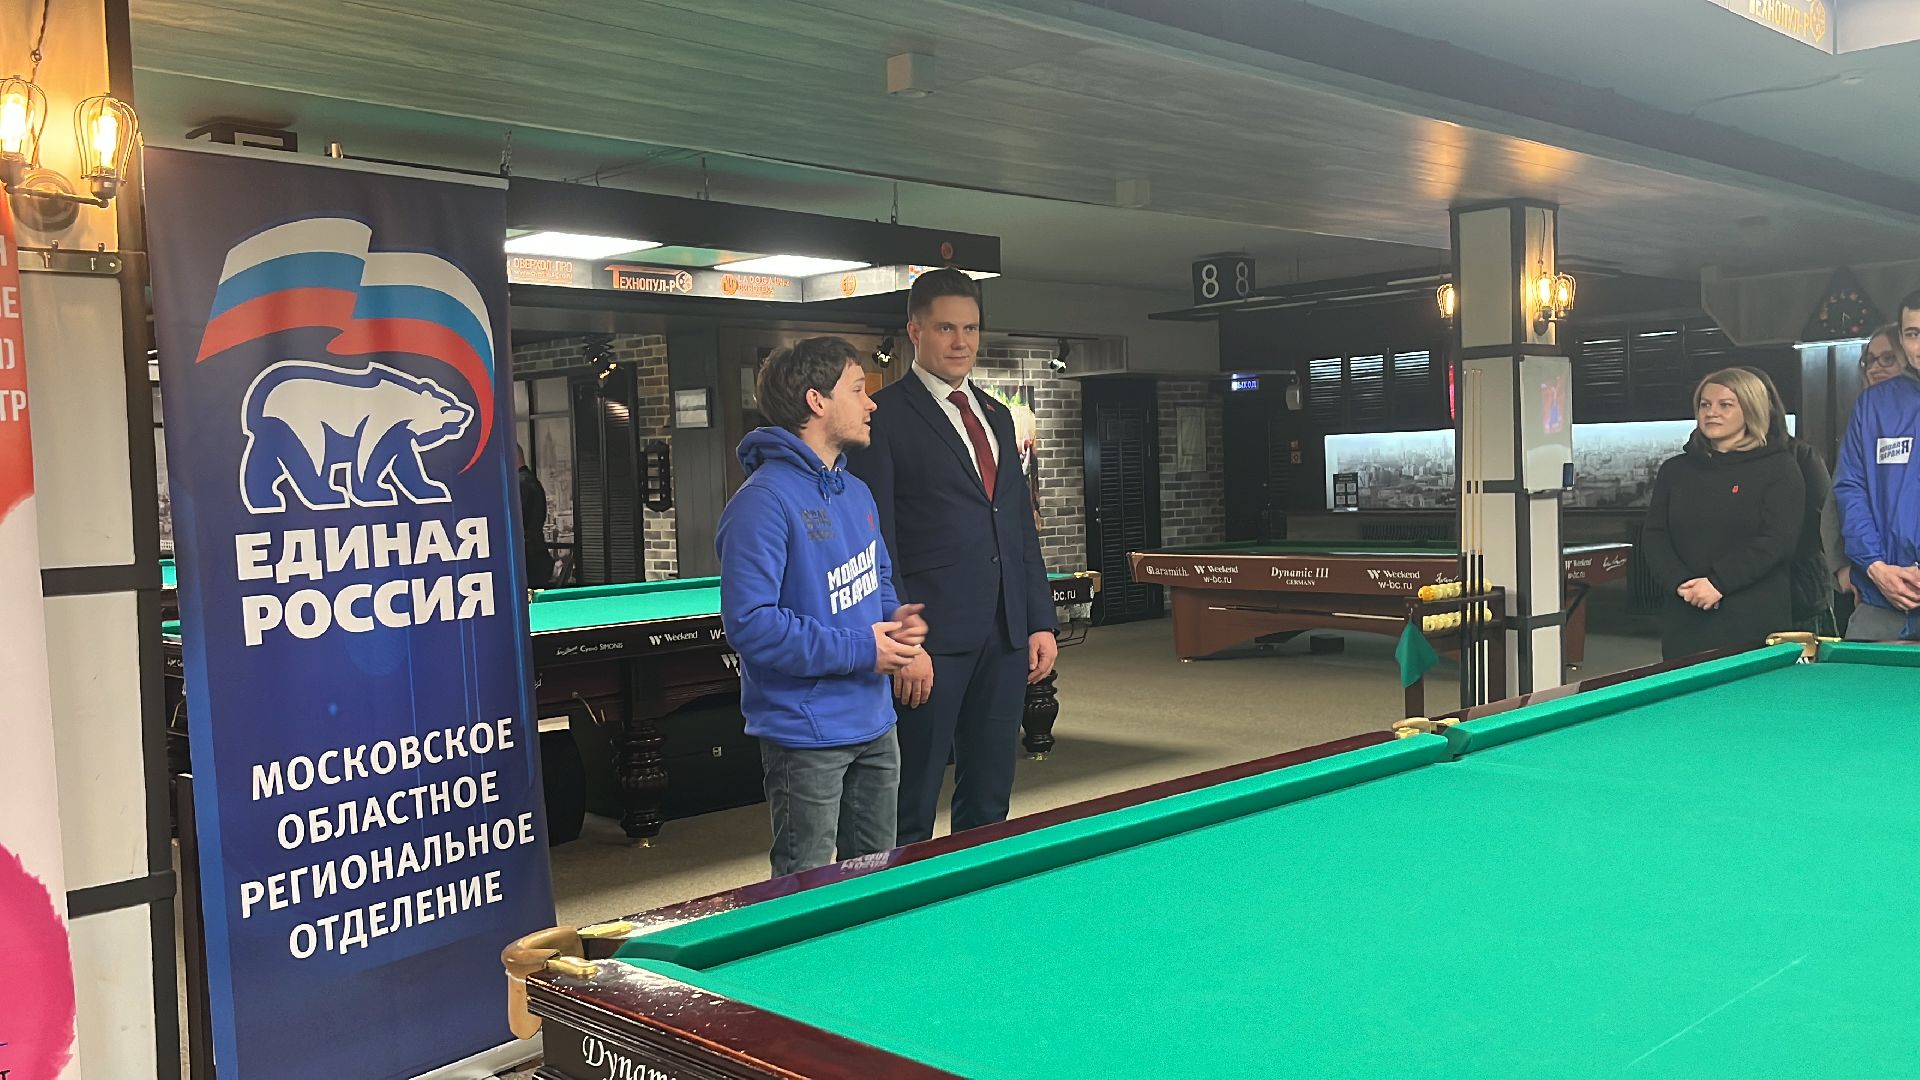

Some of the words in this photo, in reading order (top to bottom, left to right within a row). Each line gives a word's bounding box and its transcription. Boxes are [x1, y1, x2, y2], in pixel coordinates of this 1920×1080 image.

[1202, 264, 1219, 298] 8
[1236, 262, 1249, 297] 8
[1232, 381, 1257, 390] ЫХОД
[235, 517, 491, 583] ЕДИНАЯ
[1203, 575, 1232, 584] w-bc.ru
[1207, 565, 1239, 573] Weekend
[1271, 566, 1313, 579] Dynamic
[1378, 580, 1412, 590] w-bc.ru
[1383, 570, 1420, 579] Weekend
[242, 571, 496, 647] РОССИЯ
[1052, 589, 1076, 602] -bc.ru
[664, 631, 698, 642] Weekend
[250, 717, 515, 802] МОСКОВСКОЕ
[276, 771, 500, 851] ОБЛАСТНОЕ
[239, 812, 536, 919] РЕГИОНАЛЬНОЕ
[288, 870, 504, 960] ОТДЕЛЕНИЕ
[582, 1035, 678, 1080] Dyna
